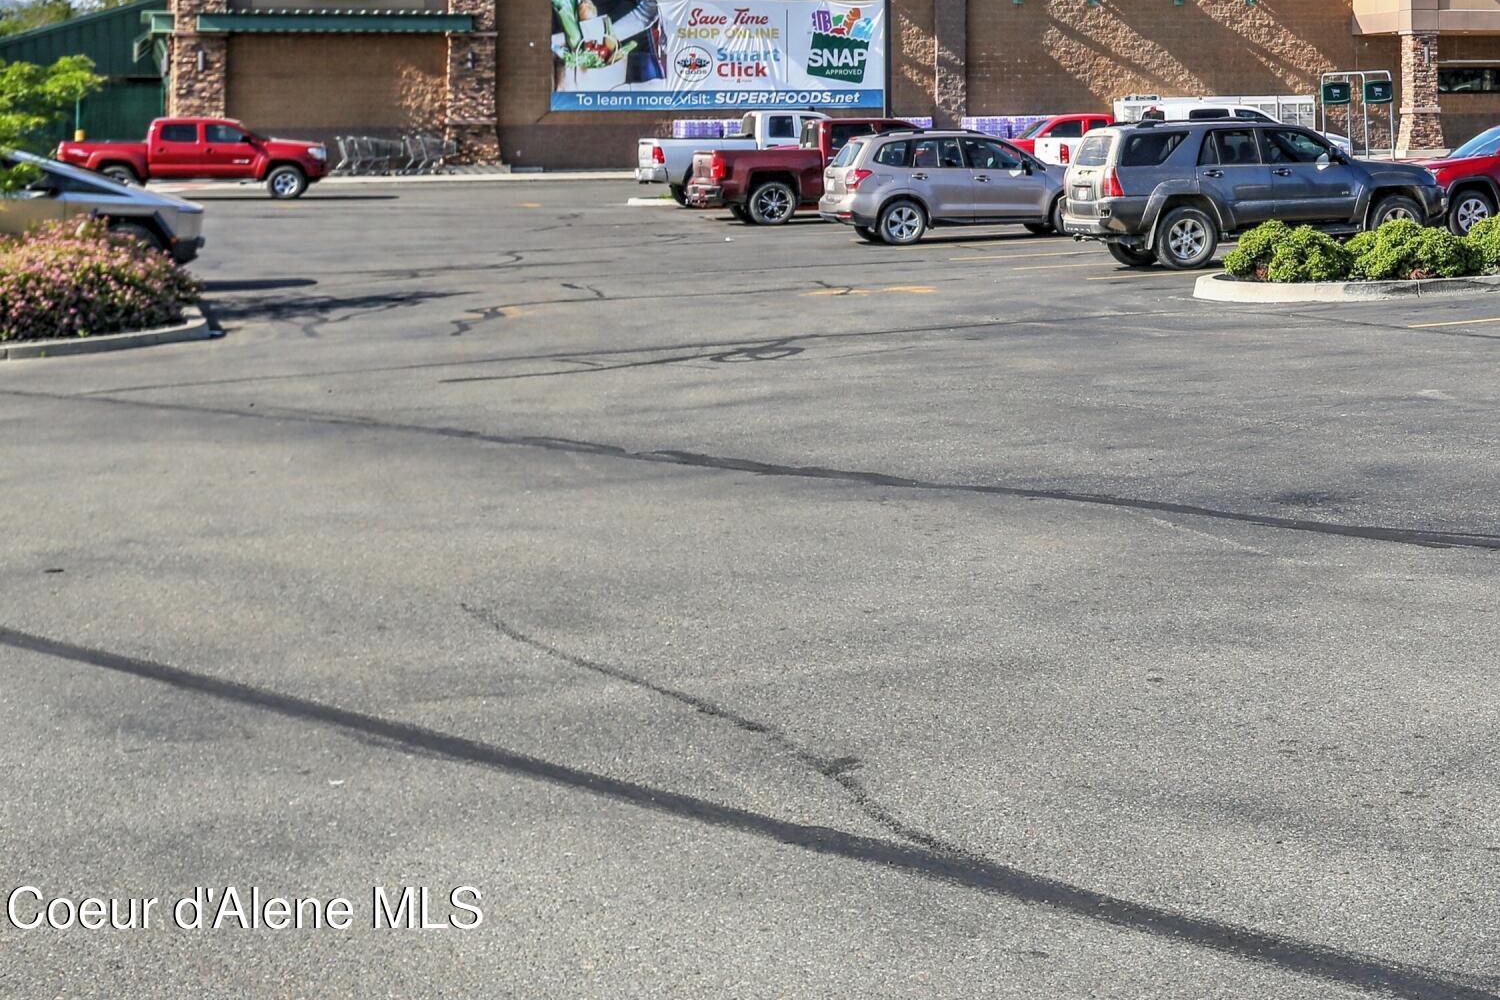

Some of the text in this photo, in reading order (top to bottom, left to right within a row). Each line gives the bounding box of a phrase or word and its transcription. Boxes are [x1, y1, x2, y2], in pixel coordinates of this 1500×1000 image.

[688, 7, 769, 27] Save Time
[677, 27, 779, 40] SHOP ONLINE
[716, 47, 781, 62] Smart
[808, 48, 869, 68] SNAP
[716, 62, 768, 78] Click
[825, 68, 863, 76] APPROVED
[576, 93, 593, 106] To
[597, 93, 632, 106] learn
[681, 93, 711, 105] visit:
[714, 91, 861, 105] SUPER1FOODS.net
